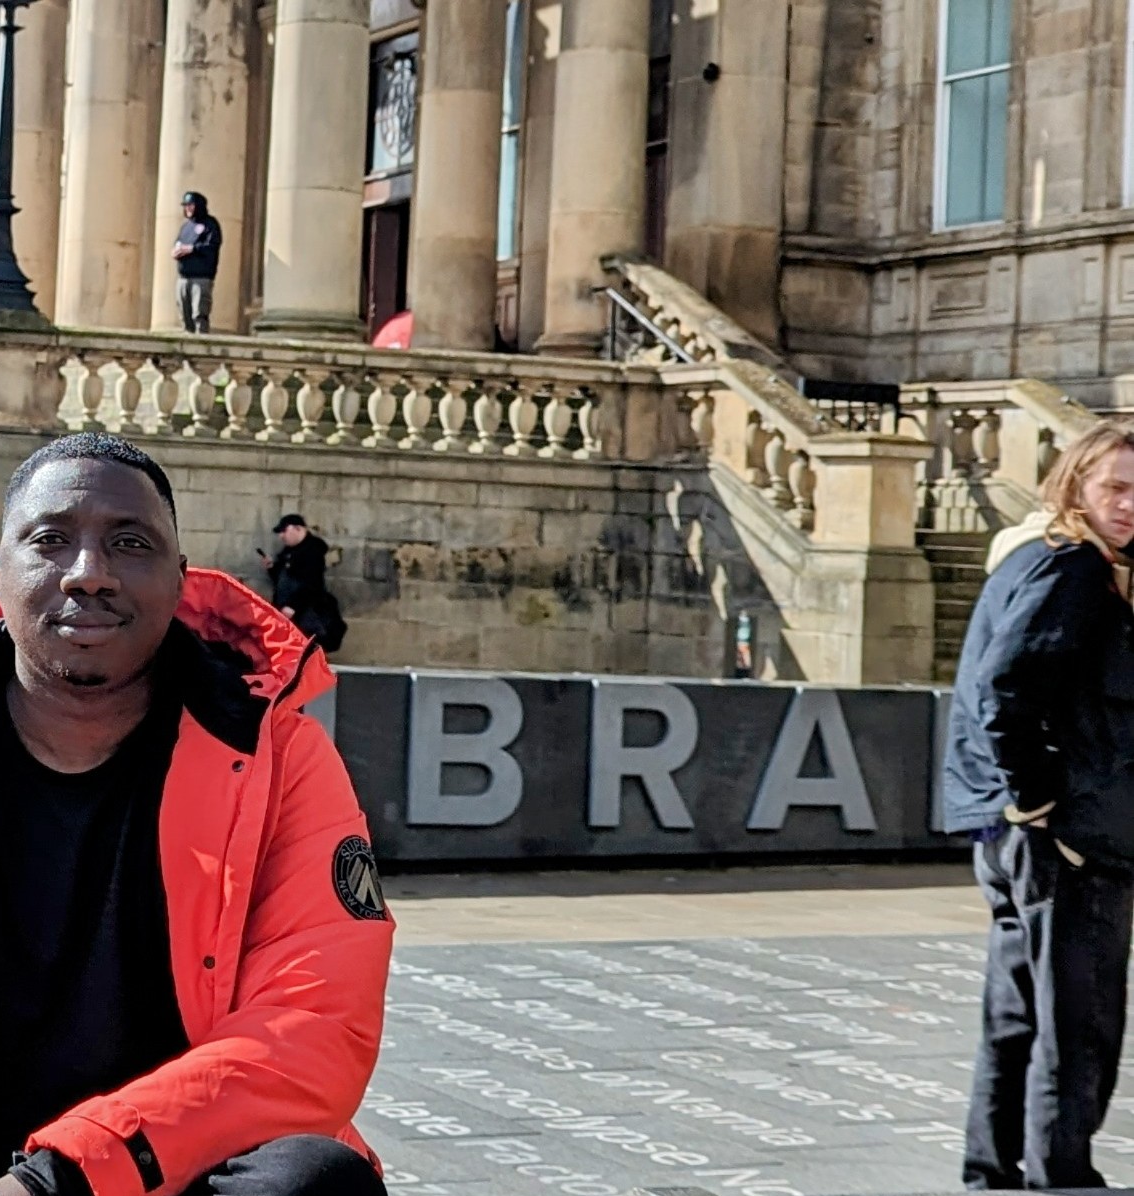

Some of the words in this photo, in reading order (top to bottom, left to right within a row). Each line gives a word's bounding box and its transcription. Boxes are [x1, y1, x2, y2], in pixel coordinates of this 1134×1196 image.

[338, 880, 358, 907] NEW
[411, 974, 503, 999] Side
[490, 999, 615, 1032] Story
[482, 963, 563, 979] All
[539, 977, 663, 1010] Quiet
[644, 1009, 716, 1027] on
[706, 1027, 797, 1050] the
[791, 1049, 971, 1110] Wester
[362, 1086, 472, 1136] olate
[384, 1002, 595, 1070] Chronicles
[579, 1071, 670, 1087] of
[629, 1089, 817, 1146] Narnia
[419, 1067, 710, 1167] Apocalypse
